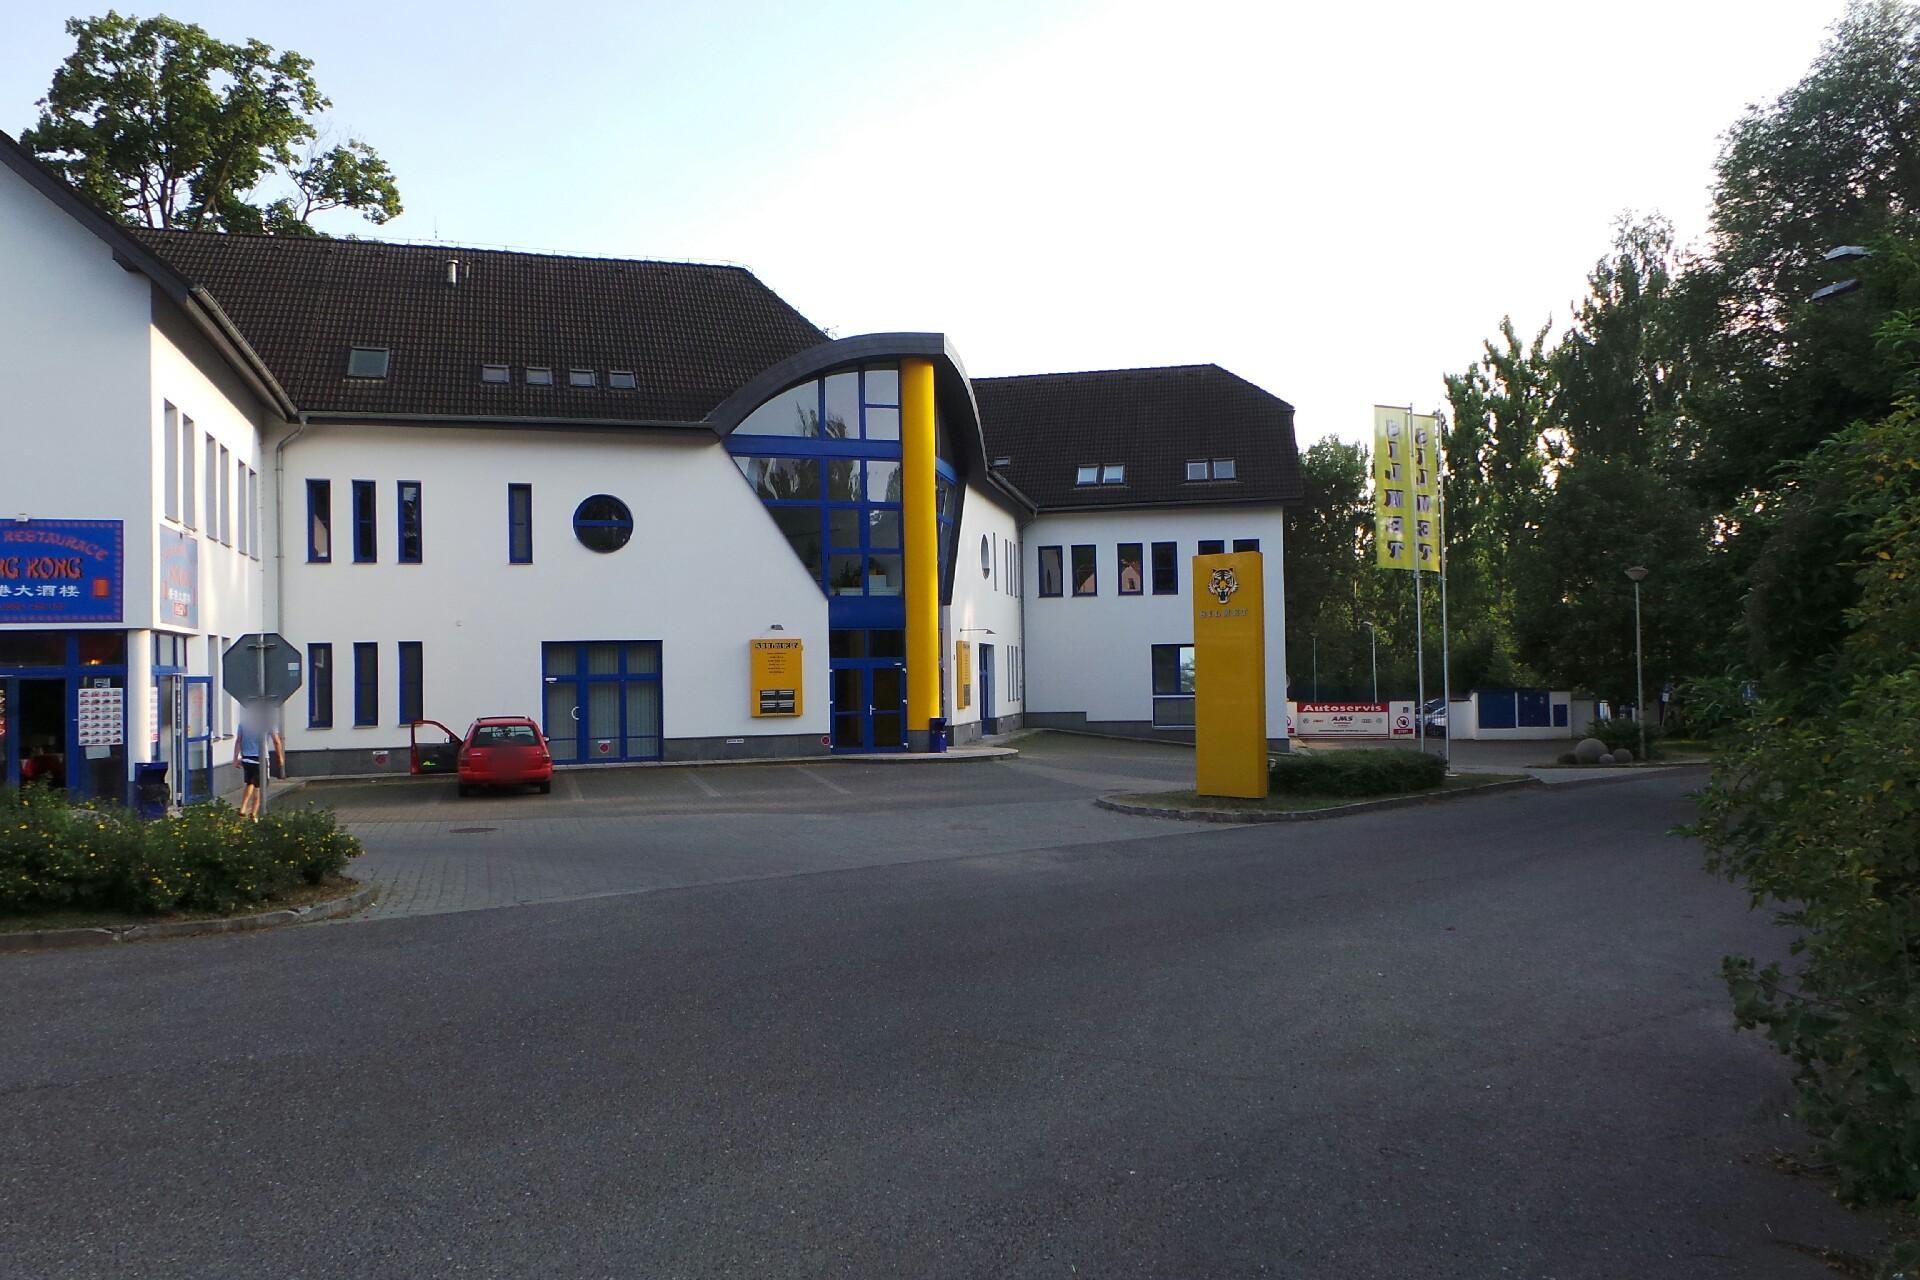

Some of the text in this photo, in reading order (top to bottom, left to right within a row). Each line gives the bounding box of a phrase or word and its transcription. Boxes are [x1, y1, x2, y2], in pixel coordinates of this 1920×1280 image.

[4, 531, 108, 561] RESTAURACE
[27, 556, 82, 579] KONG
[1303, 704, 1382, 712] Autoservis
